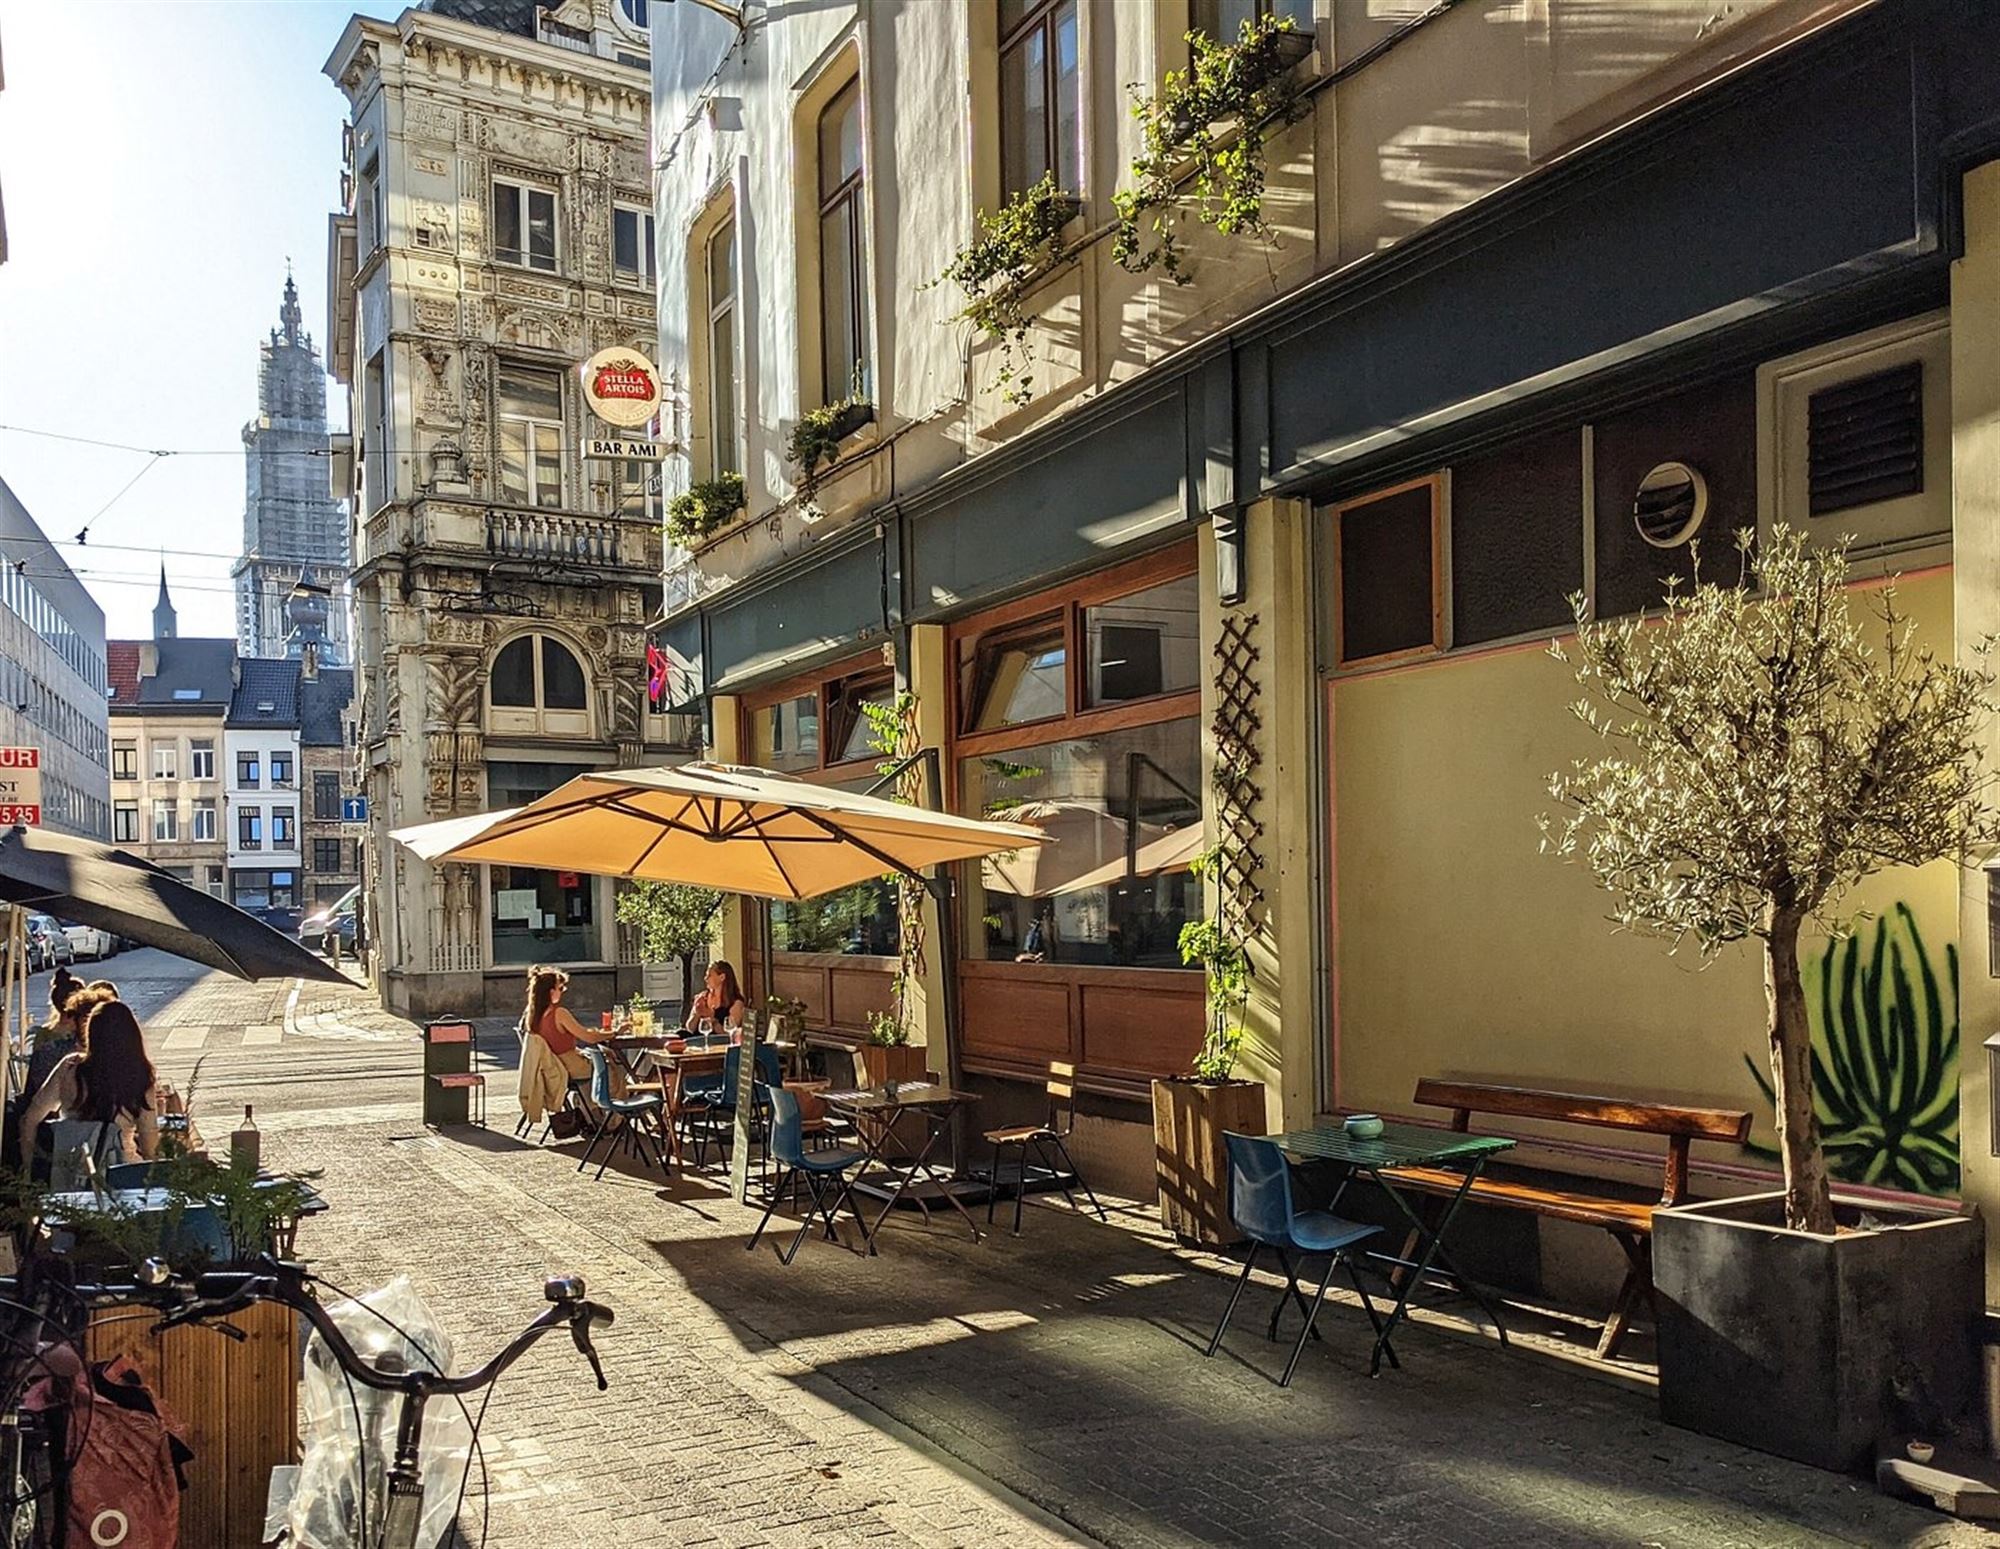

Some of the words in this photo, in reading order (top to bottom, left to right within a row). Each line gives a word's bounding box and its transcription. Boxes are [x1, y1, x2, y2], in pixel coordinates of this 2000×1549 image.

[604, 375, 644, 385] STELLA
[604, 384, 646, 394] ARTOIS
[593, 441, 623, 455] BAR
[628, 444, 657, 457] AMI
